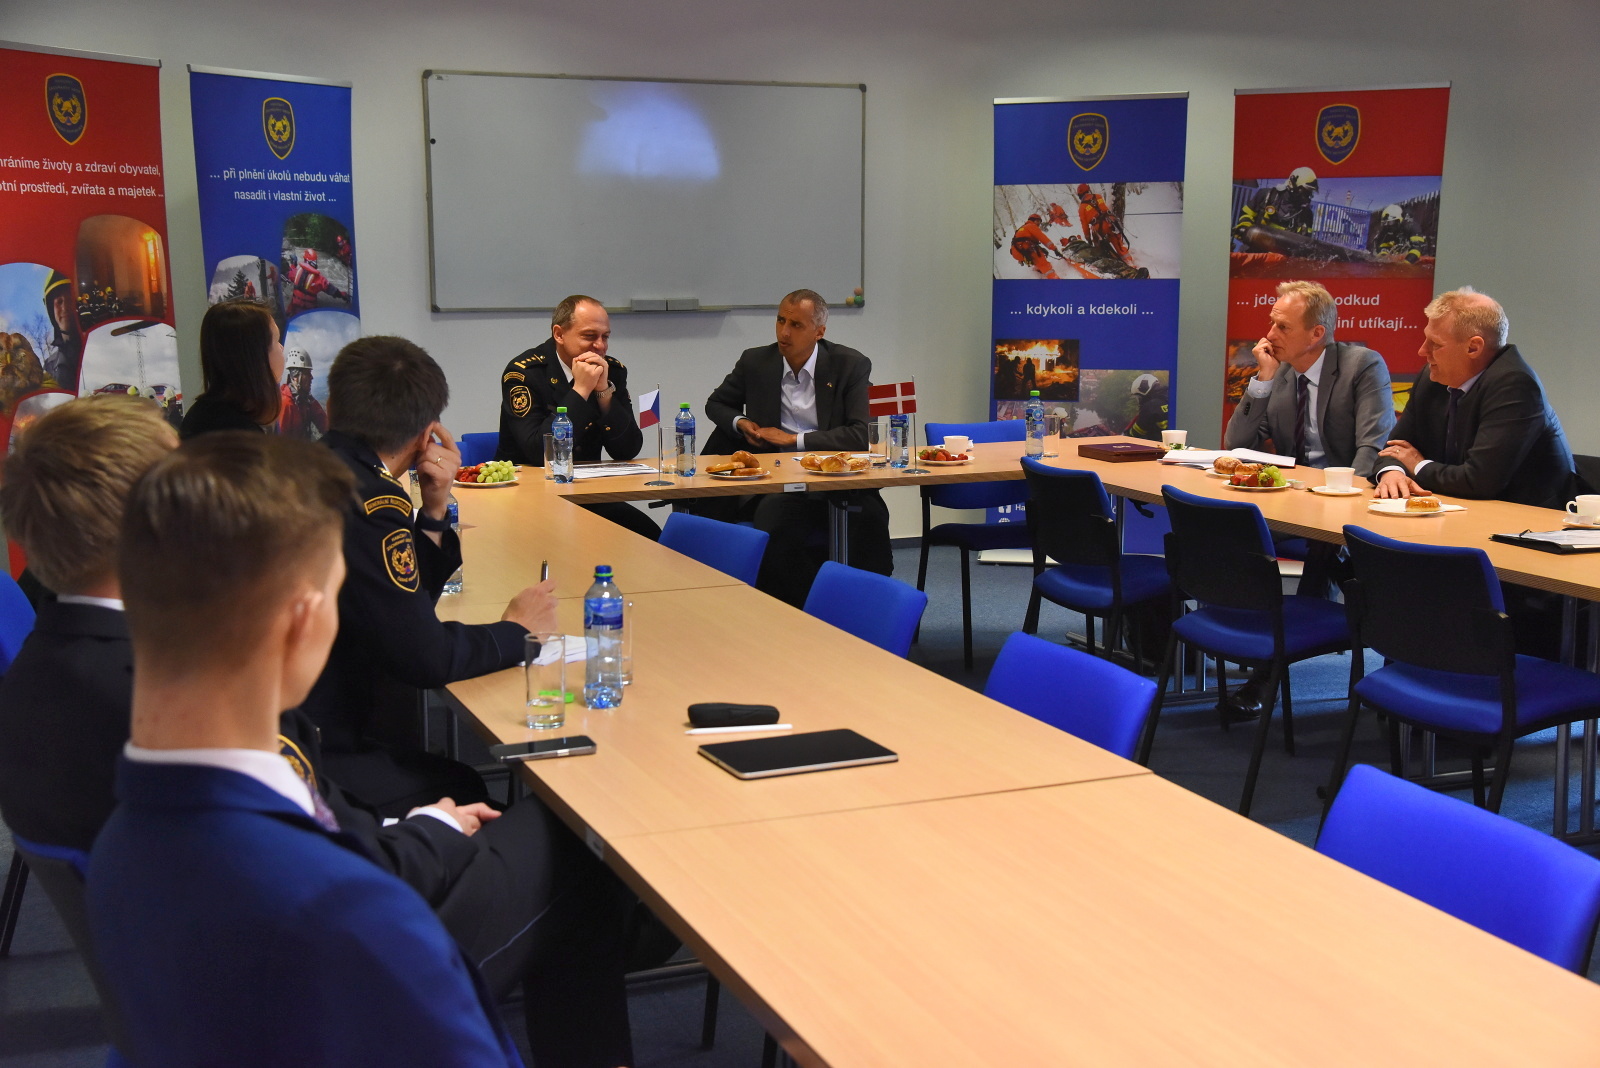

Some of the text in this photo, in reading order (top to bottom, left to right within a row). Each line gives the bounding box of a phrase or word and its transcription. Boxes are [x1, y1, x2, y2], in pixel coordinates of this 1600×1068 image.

[42, 158, 72, 174] životy
[75, 162, 83, 172] a
[85, 161, 117, 173] zdraví
[119, 163, 161, 177] obyvatel,
[223, 167, 237, 181] při
[239, 168, 265, 181] plnění
[267, 169, 291, 181] úkolů
[293, 171, 327, 183] nebudu
[329, 172, 351, 183] váhat
[20, 181, 69, 195] prostředí,
[71, 183, 106, 196] zvířata
[108, 186, 116, 196] a
[117, 185, 157, 198] majetek
[234, 189, 266, 200] nasadit
[268, 190, 272, 200] i
[273, 190, 302, 201] vlastní
[304, 190, 326, 202] život
[1253, 293, 1280, 308] jde
[1334, 294, 1380, 306] odkud
[1026, 303, 1073, 317] kdykoli
[1077, 305, 1086, 315] a
[1089, 303, 1137, 315] kdekoli
[1334, 316, 1418, 331] iní utíkají...
